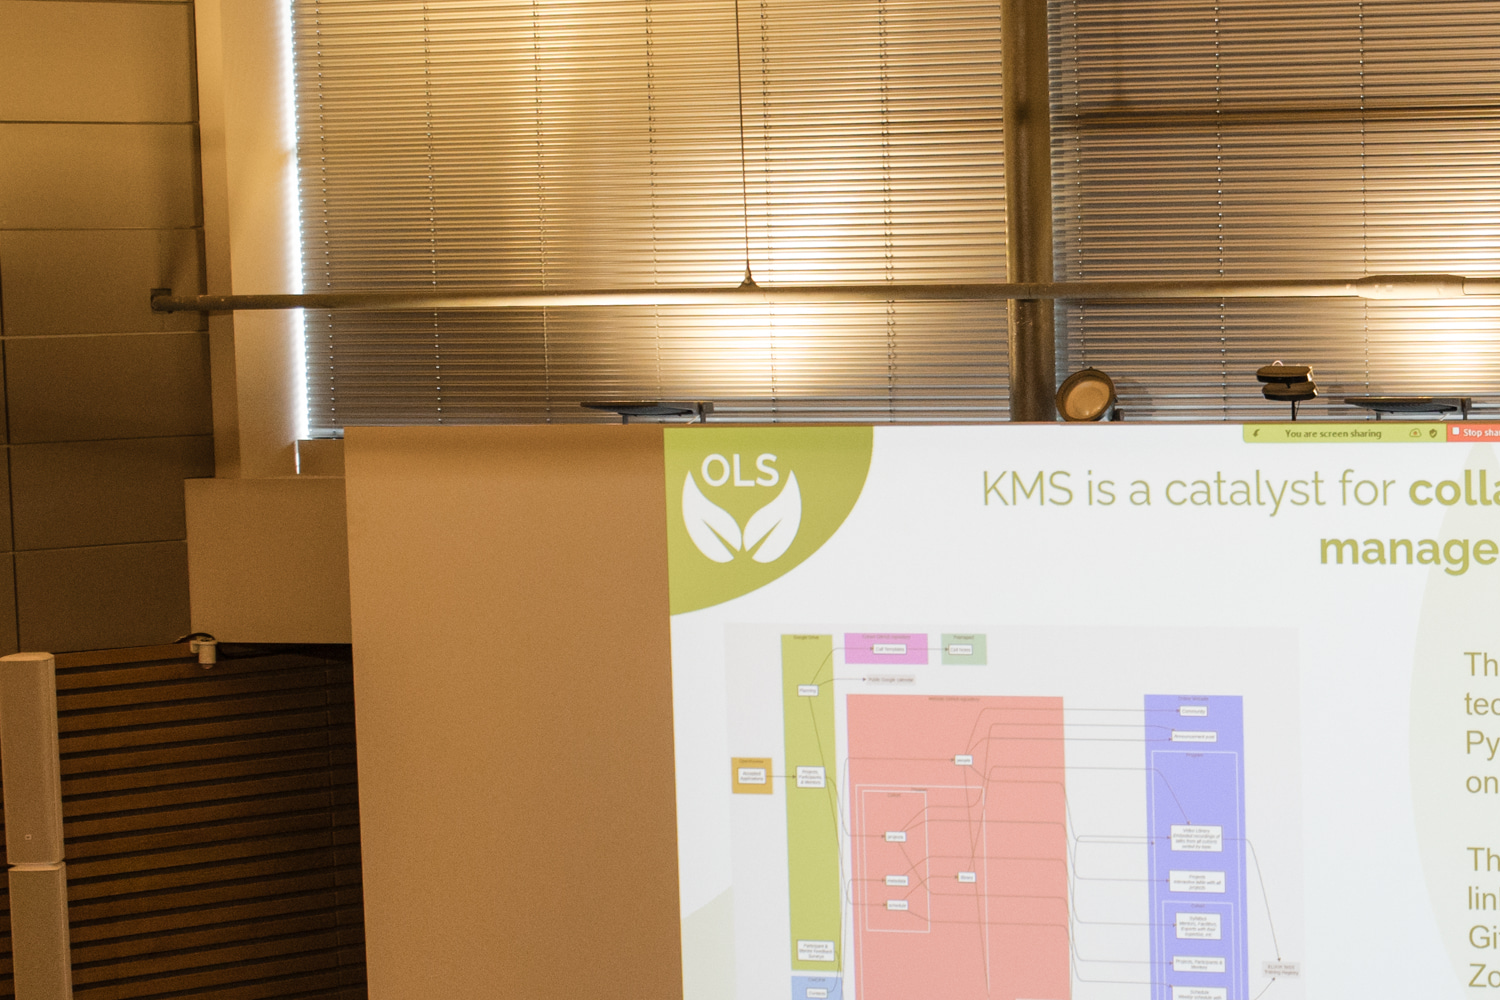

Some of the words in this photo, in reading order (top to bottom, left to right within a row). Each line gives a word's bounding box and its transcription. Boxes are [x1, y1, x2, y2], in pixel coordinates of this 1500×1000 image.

[1285, 429, 1302, 438] You
[1350, 429, 1382, 440] sharing
[1463, 428, 1483, 438] Stop
[701, 453, 779, 487] OLS
[983, 470, 1074, 507] KMS
[1087, 469, 1117, 507] is
[1129, 479, 1152, 507] a
[1165, 469, 1326, 517] catalyst
[1339, 468, 1396, 507] for
[1465, 775, 1499, 794] on
